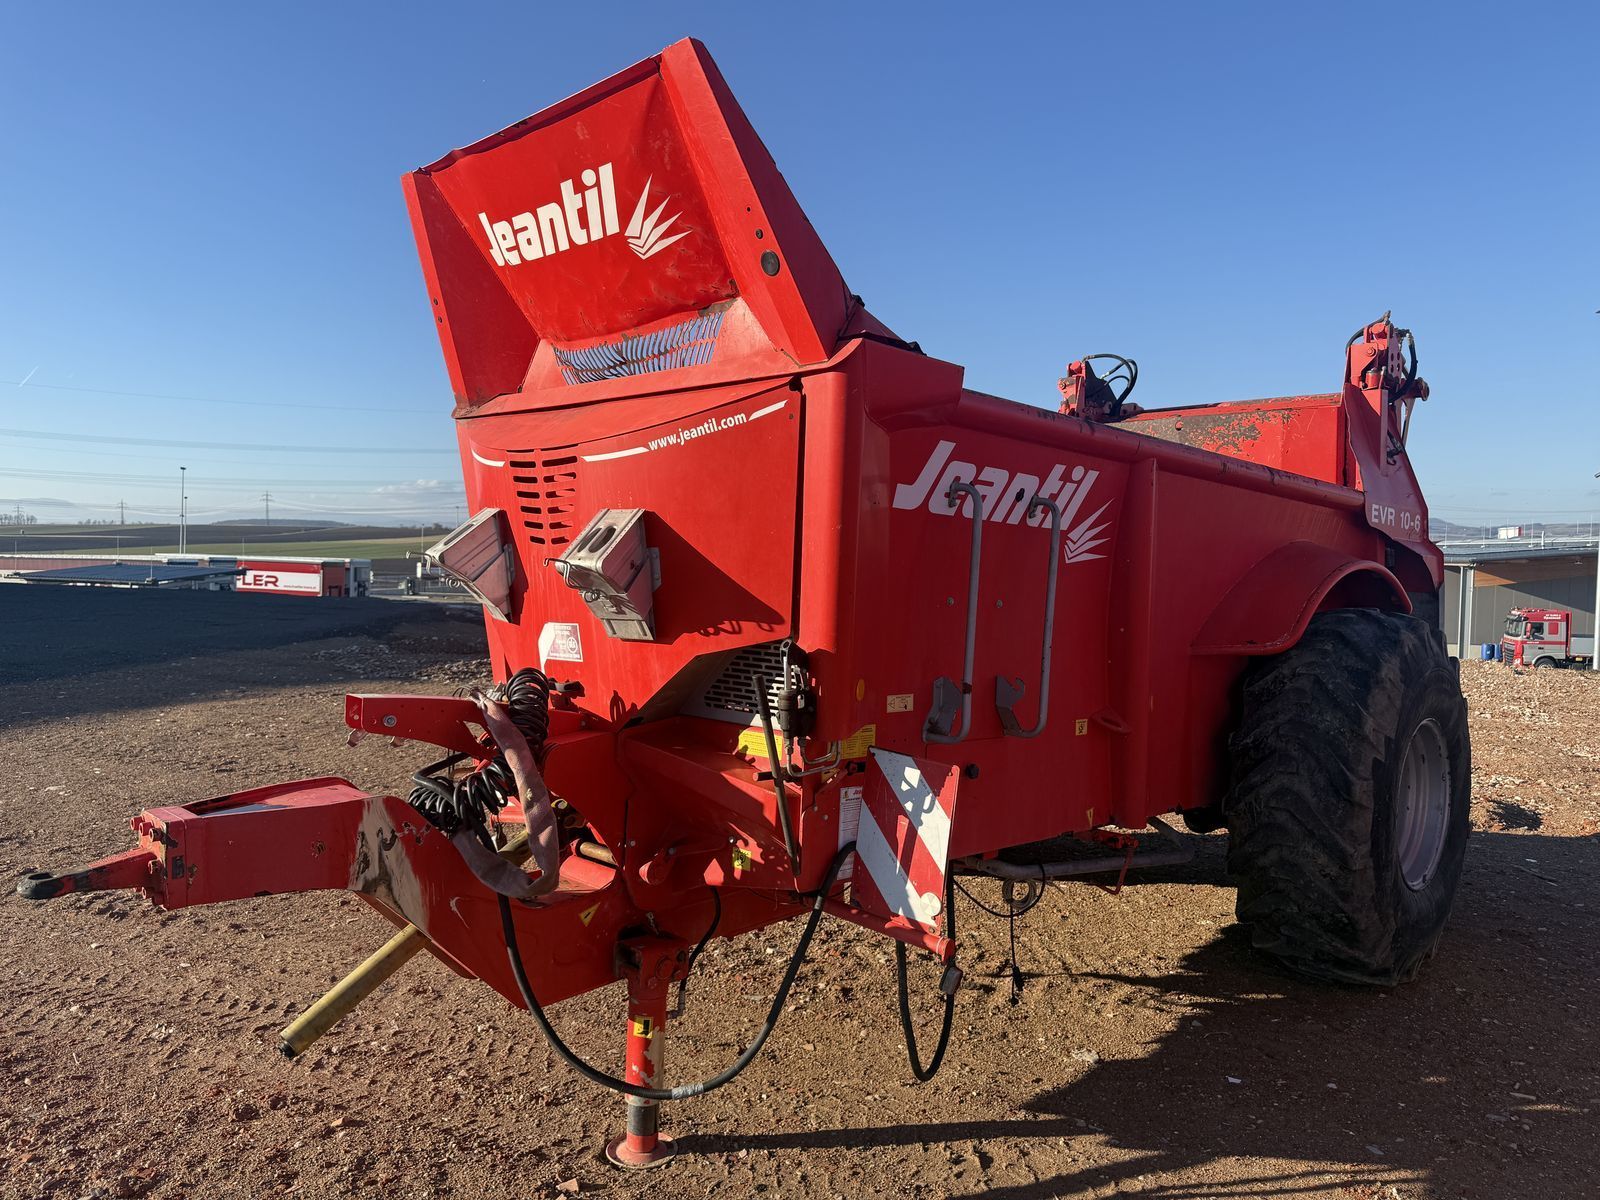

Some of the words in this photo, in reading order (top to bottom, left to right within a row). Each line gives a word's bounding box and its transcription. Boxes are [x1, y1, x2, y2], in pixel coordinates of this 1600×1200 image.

[478, 162, 620, 267] Jeantil
[648, 412, 747, 451] www.jeantil.com
[892, 440, 1100, 531] Jeantil
[1371, 504, 1396, 526] EVR
[1400, 511, 1421, 532] 10-6
